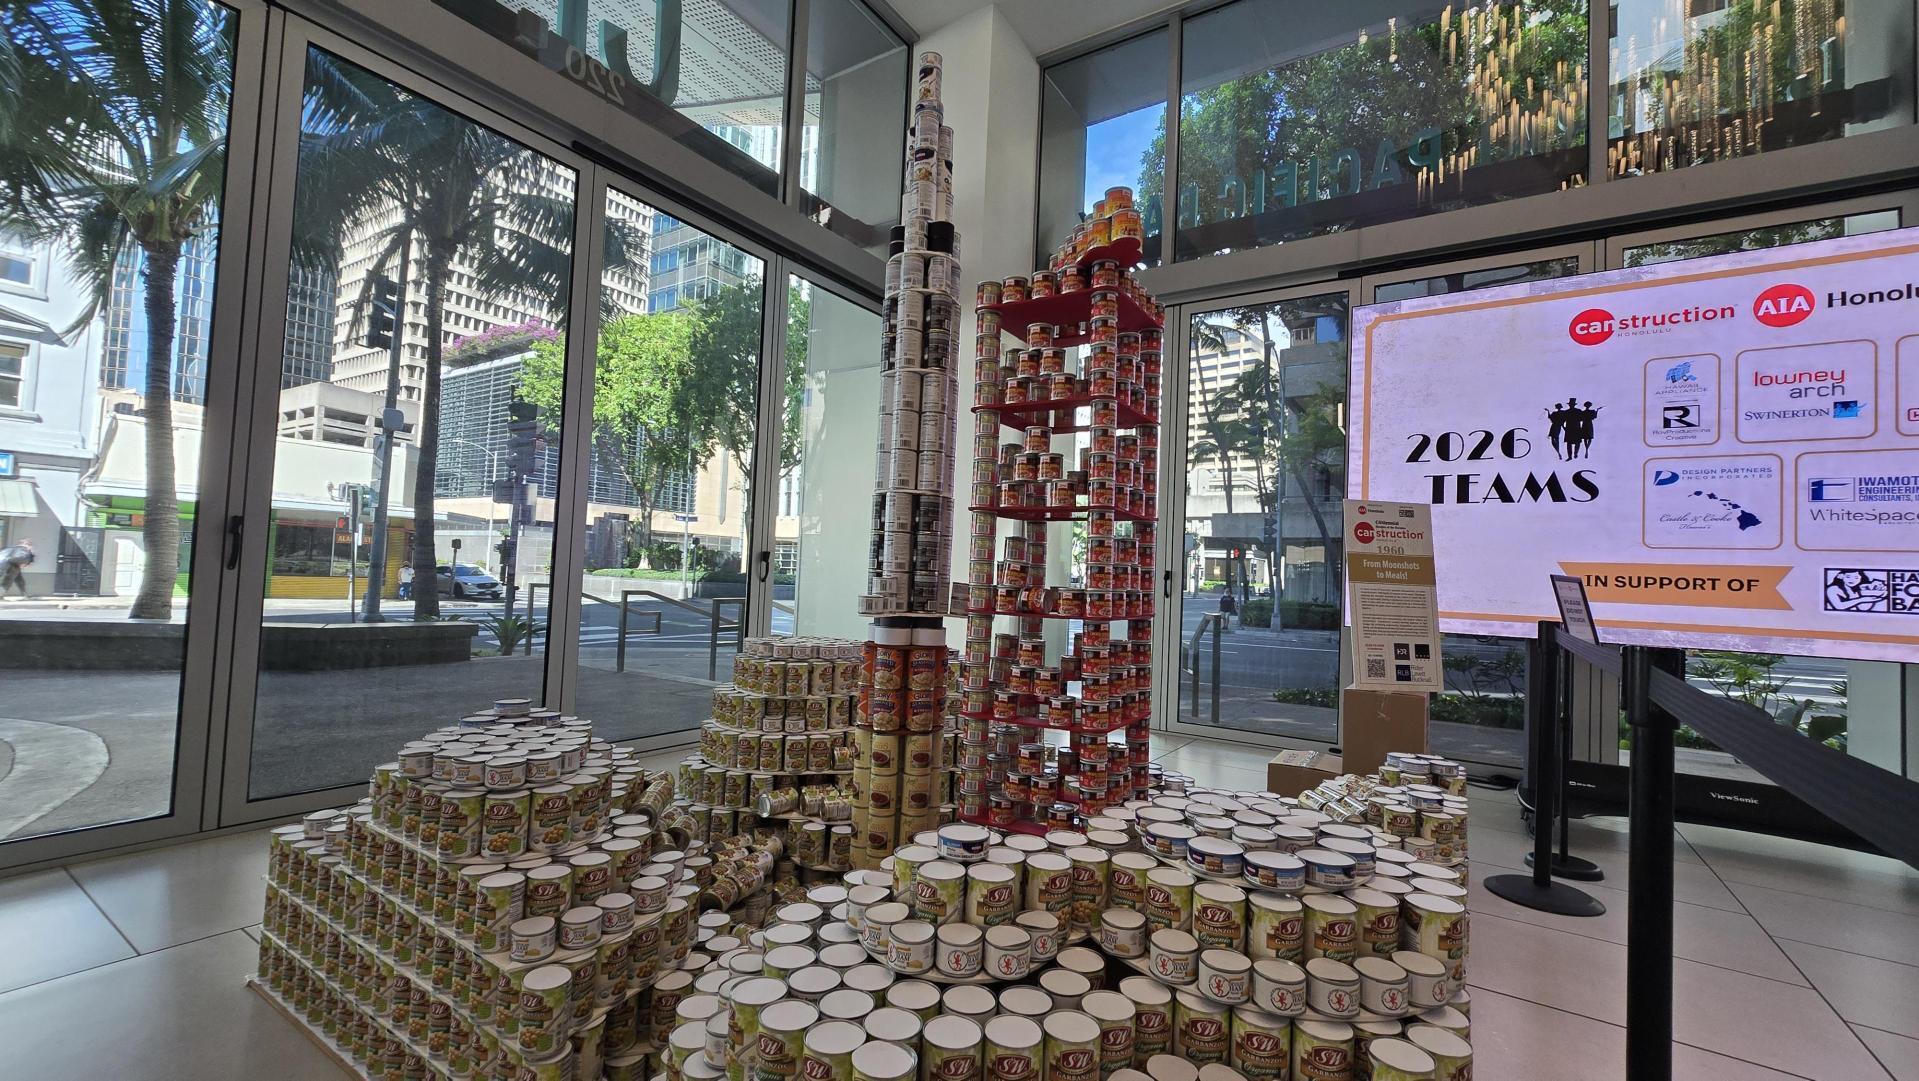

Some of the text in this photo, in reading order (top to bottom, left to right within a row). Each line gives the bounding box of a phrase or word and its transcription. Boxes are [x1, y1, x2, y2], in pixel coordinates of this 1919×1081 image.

[1757, 283, 1919, 316] AIA Honol
[1574, 305, 1736, 336] canstruction
[1617, 328, 1672, 338] HONOLULU
[1753, 369, 1845, 387] lowney
[1789, 382, 1845, 399] arch
[1744, 408, 1831, 421] SWINERTON
[1405, 427, 1532, 463] 2026
[1424, 470, 1600, 504] TEAMS
[1810, 508, 1919, 524] WhiteSpac
[1357, 528, 1424, 540] canstruction
[1377, 545, 1405, 555] 1960
[1363, 560, 1420, 570] From Moonshots
[1385, 571, 1408, 580] Meals!
[1585, 575, 1760, 592] IN SUPPORT OF
[1709, 791, 1759, 805] ViewSonic
[1203, 907, 1230, 922] S&W
[1137, 1012, 1163, 1028] S&W
[1192, 1020, 1218, 1036] S&W
[760, 1037, 782, 1055] S&W
[1103, 1029, 1129, 1046] S&W
[1247, 1035, 1276, 1051] S&W
[998, 1057, 1026, 1074] S&W
[1064, 1051, 1090, 1069] S&W
[1316, 1049, 1342, 1066] S&W
[806, 1060, 828, 1079] S&W
[944, 1058, 970, 1075] S&W
